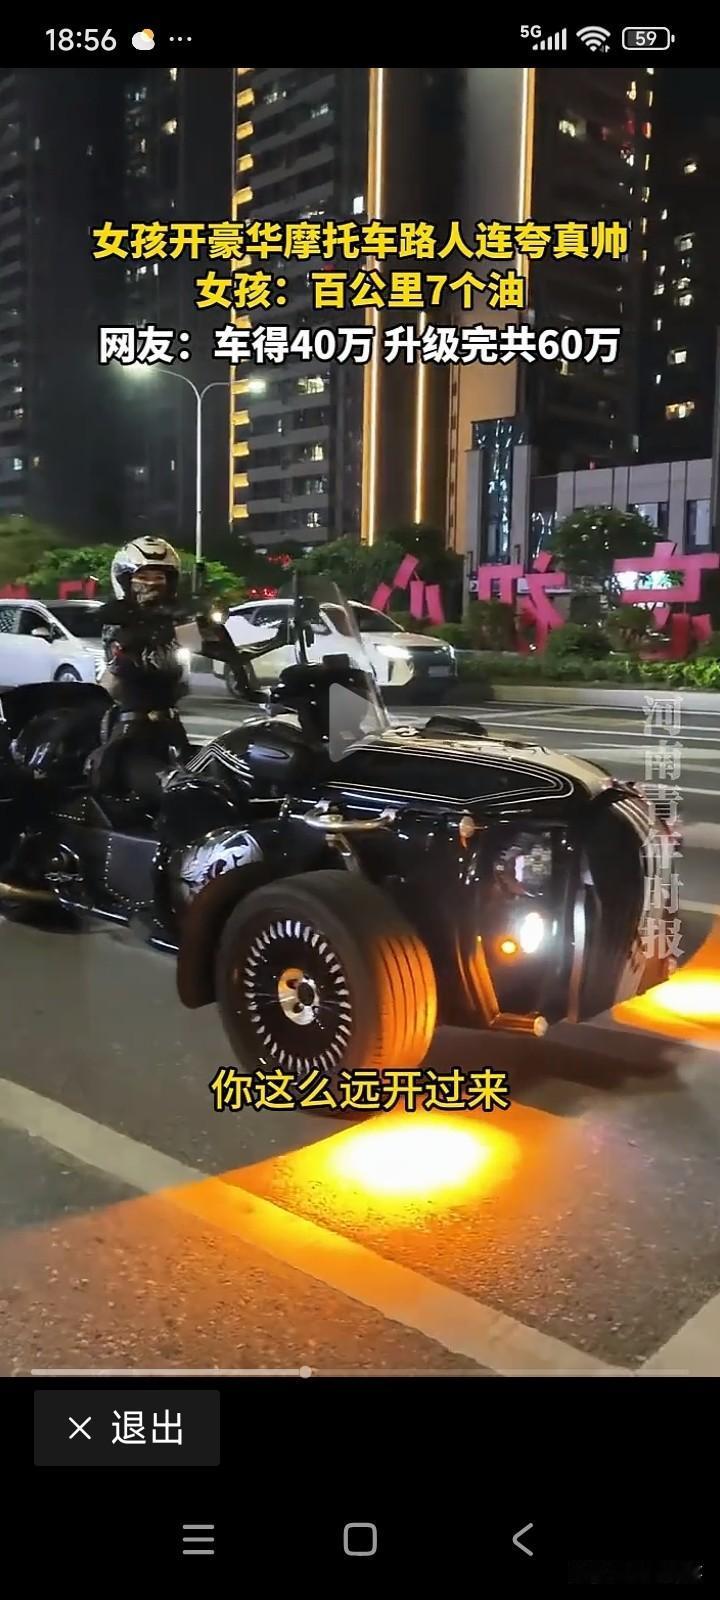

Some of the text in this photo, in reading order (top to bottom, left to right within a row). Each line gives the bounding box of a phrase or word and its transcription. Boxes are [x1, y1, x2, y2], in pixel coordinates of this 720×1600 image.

[45, 28, 117, 52] 18:56
[520, 25, 542, 38] 5G
[635, 31, 657, 46] 59
[111, 1409, 184, 1446] 退出
